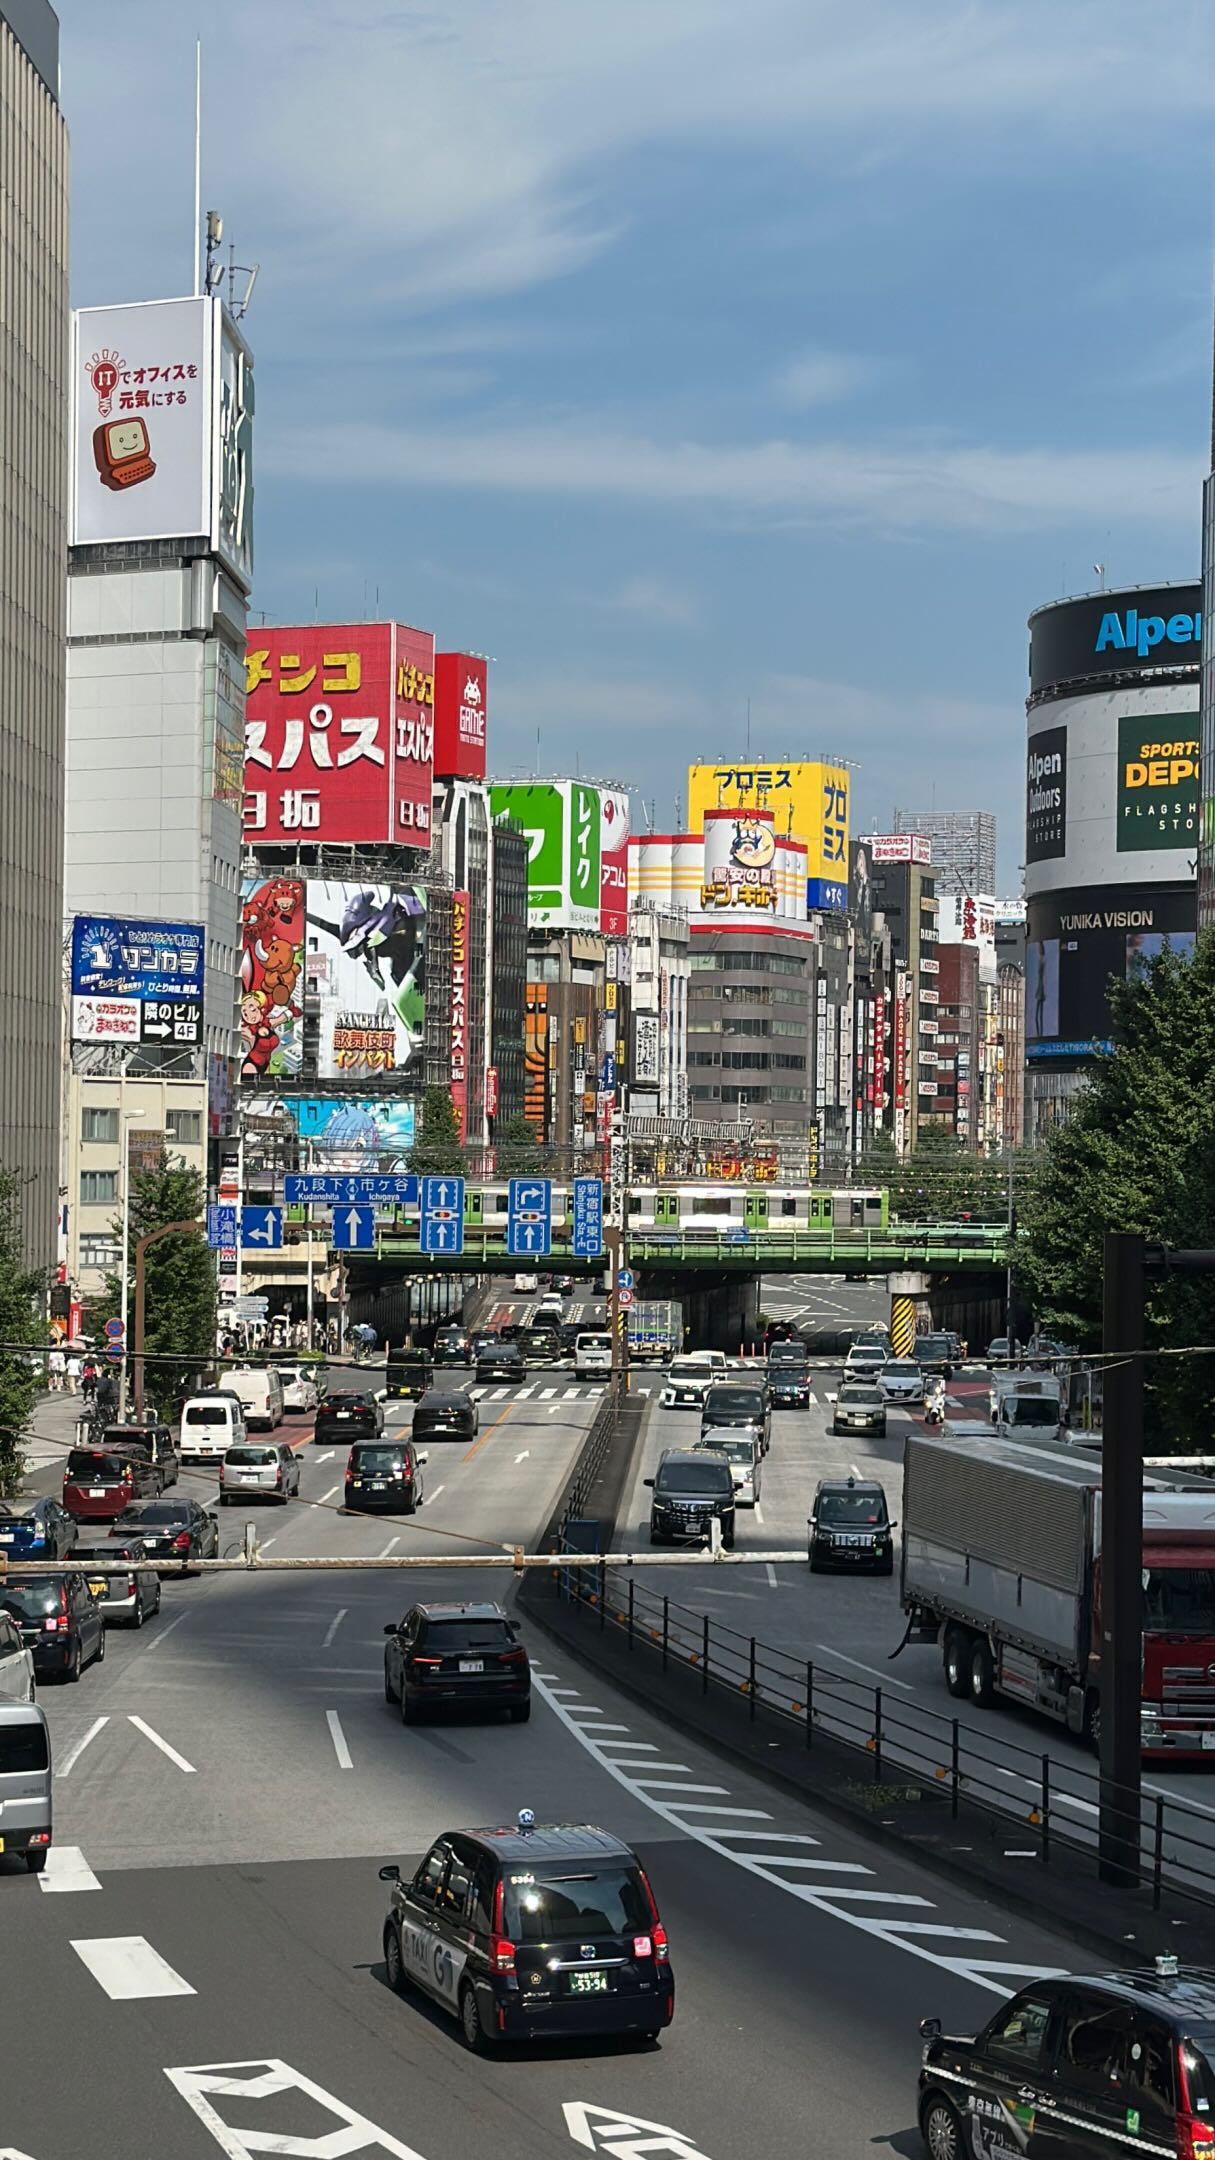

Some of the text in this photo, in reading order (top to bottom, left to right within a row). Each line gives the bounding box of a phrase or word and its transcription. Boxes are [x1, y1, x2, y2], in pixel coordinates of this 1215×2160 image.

[119, 390, 187, 409] 元気にする
[397, 656, 434, 706] パチンコ
[460, 705, 485, 737] GAME
[396, 711, 434, 764] エスパス
[717, 769, 792, 789] プロミス
[1028, 752, 1062, 785] Alpen
[1125, 760, 1200, 788] DEP
[576, 791, 593, 890] レイク
[602, 864, 626, 888] アコム
[452, 900, 464, 962] パチンコ
[1060, 911, 1153, 930] YUNIKA VISION
[920, 928, 939, 942] DARTS
[121, 945, 199, 974] ワンカラ
[144, 1001, 200, 1022] 隣のビル
[452, 966, 464, 1049] エスパス
[177, 1025, 194, 1038] 4F
[334, 1030, 397, 1049] 歌舞伎町
[335, 1050, 397, 1069] インパクト
[294, 1178, 344, 1192] 九段下
[298, 1193, 400, 1203] Kudanshita Ichigaya
[575, 1184, 586, 1220] Shinjuku
[586, 1183, 599, 1252] 新宿駅東口
